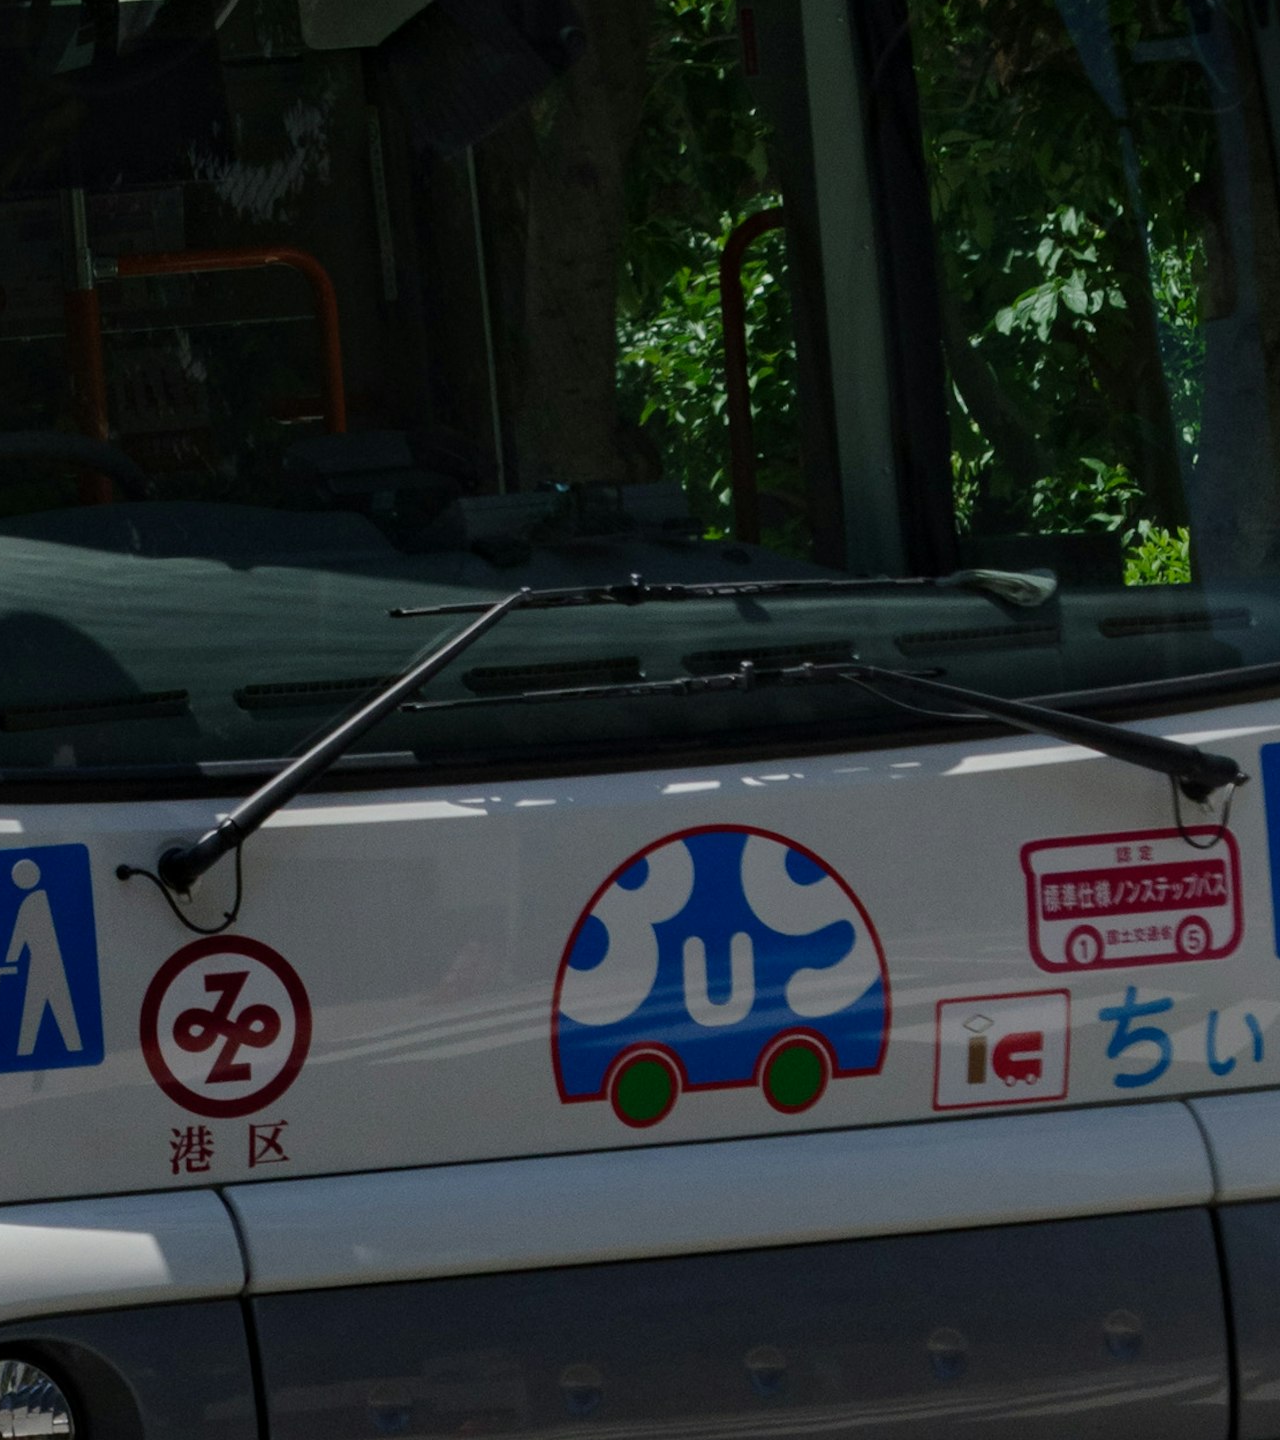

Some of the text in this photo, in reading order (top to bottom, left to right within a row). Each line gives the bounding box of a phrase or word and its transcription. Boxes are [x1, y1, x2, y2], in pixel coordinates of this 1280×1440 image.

[1043, 872, 1227, 913] 標準仕様ノンステップバス
[1078, 940, 1090, 960] 1
[1187, 930, 1201, 951] 5
[168, 1120, 290, 1174] 港区
